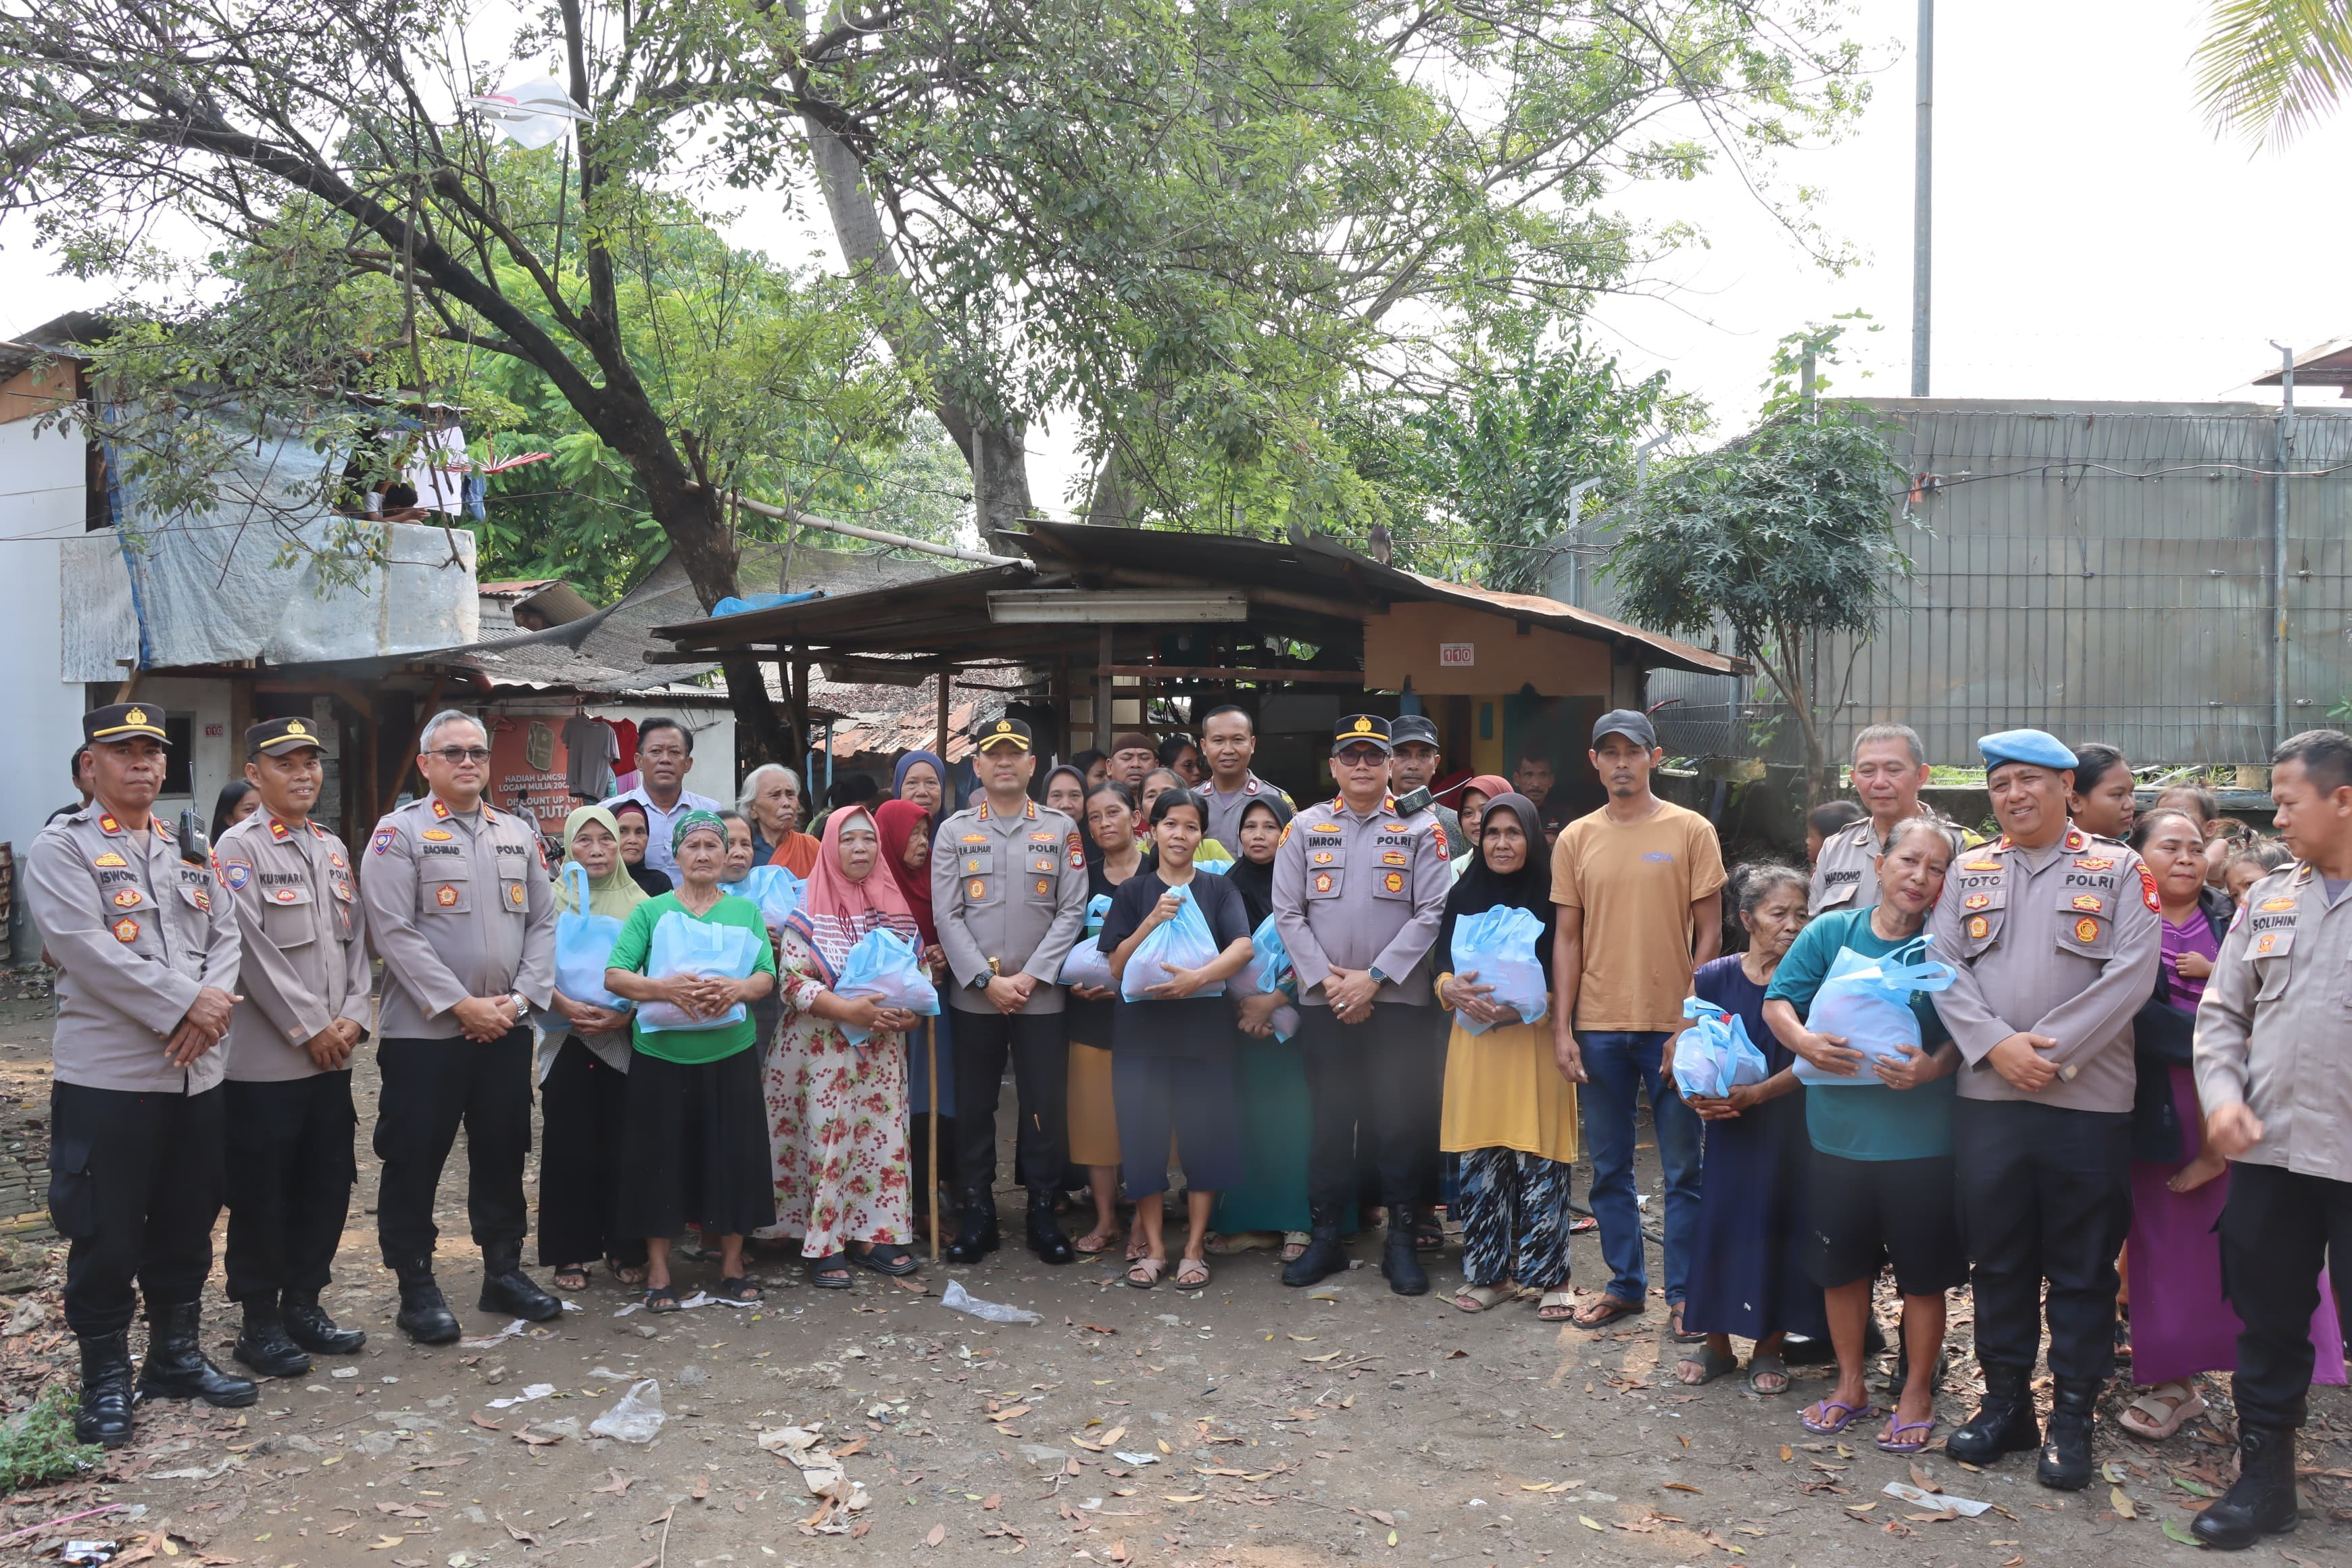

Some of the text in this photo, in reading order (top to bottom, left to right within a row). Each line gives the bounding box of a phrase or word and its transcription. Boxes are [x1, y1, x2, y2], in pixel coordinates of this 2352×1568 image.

[1445, 650, 1471, 660] 110
[505, 773, 568, 783] HADIAH LANGSU
[499, 781, 570, 792] LOGAM MULIA 20G
[506, 796, 551, 806] DISCOUNT
[553, 795, 564, 804] UP
[539, 804, 572, 819] JUTA
[1308, 837, 1342, 848] IMRON
[1377, 835, 1411, 846] POLRI
[495, 845, 526, 855] POLRI
[1028, 844, 1058, 854] POLRI
[1959, 875, 2001, 889] TOTO
[2065, 874, 2115, 889] POLRI
[2253, 915, 2297, 932] SOLIHIN
